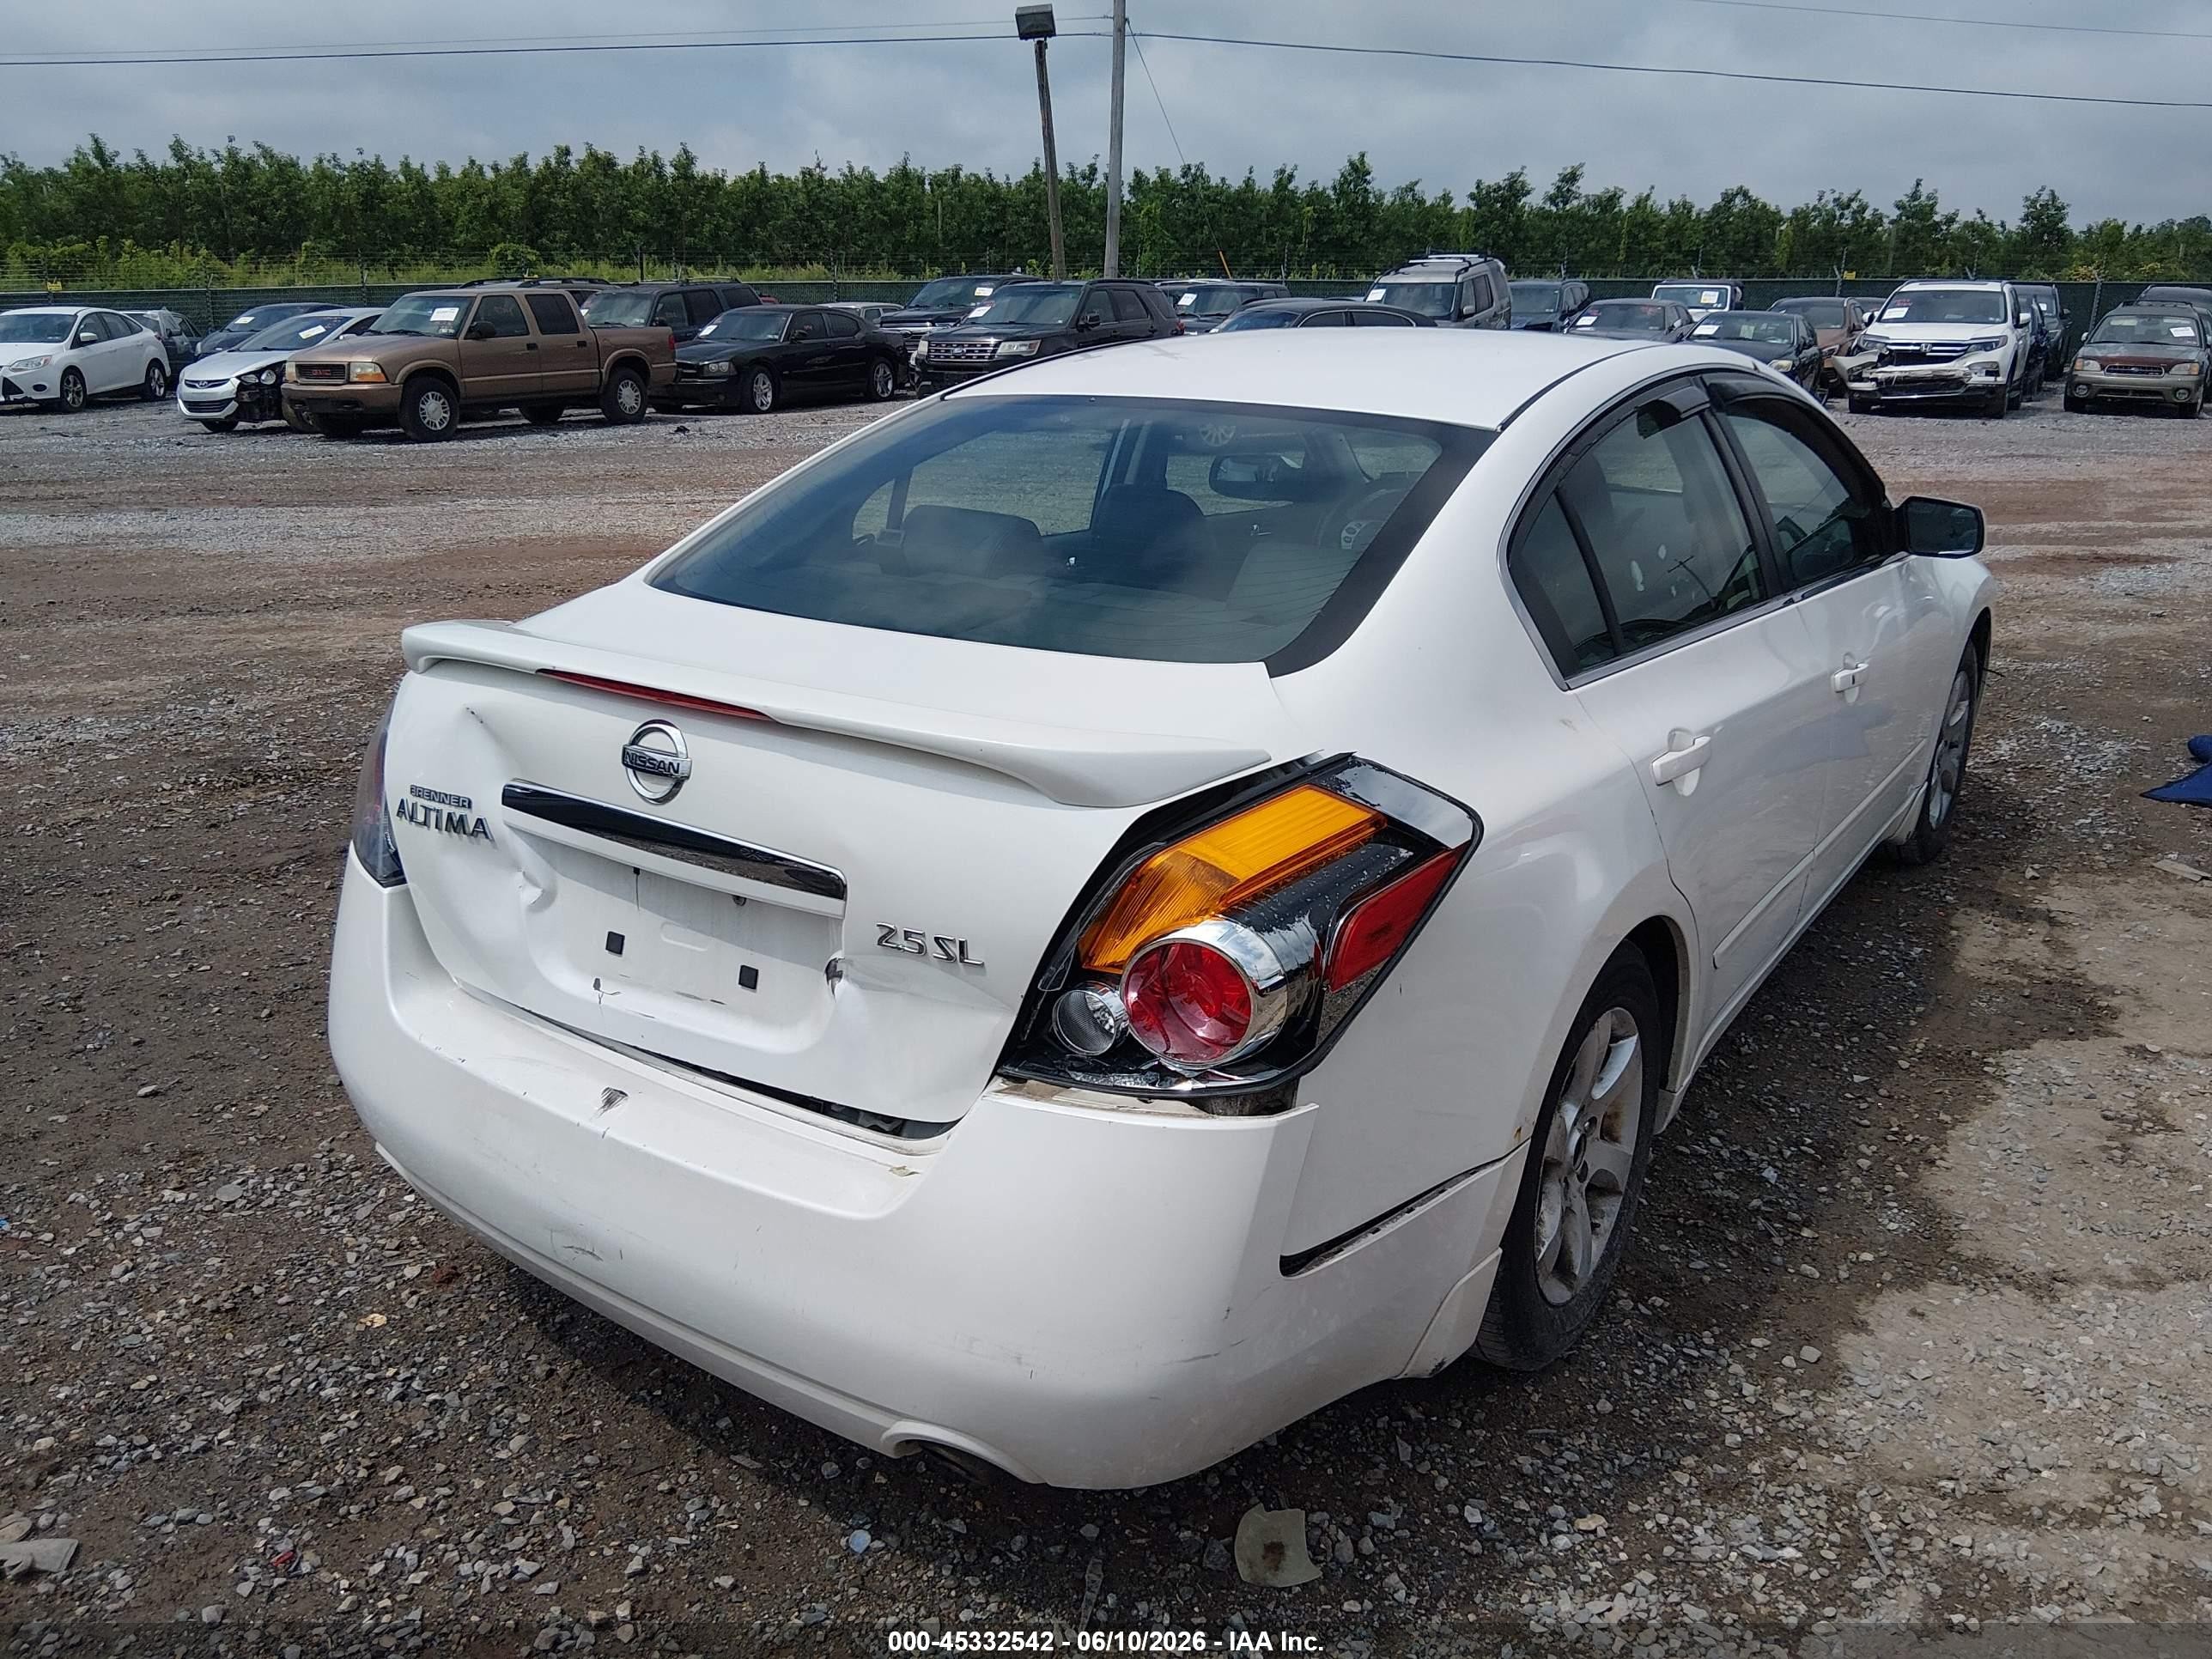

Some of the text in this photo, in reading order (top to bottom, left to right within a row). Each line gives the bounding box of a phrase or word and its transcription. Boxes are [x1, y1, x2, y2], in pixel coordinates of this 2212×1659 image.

[624, 750, 680, 775] NISSAN
[410, 784, 472, 809] BRENNER
[396, 798, 495, 842] ALTIMA
[933, 934, 985, 967] SL
